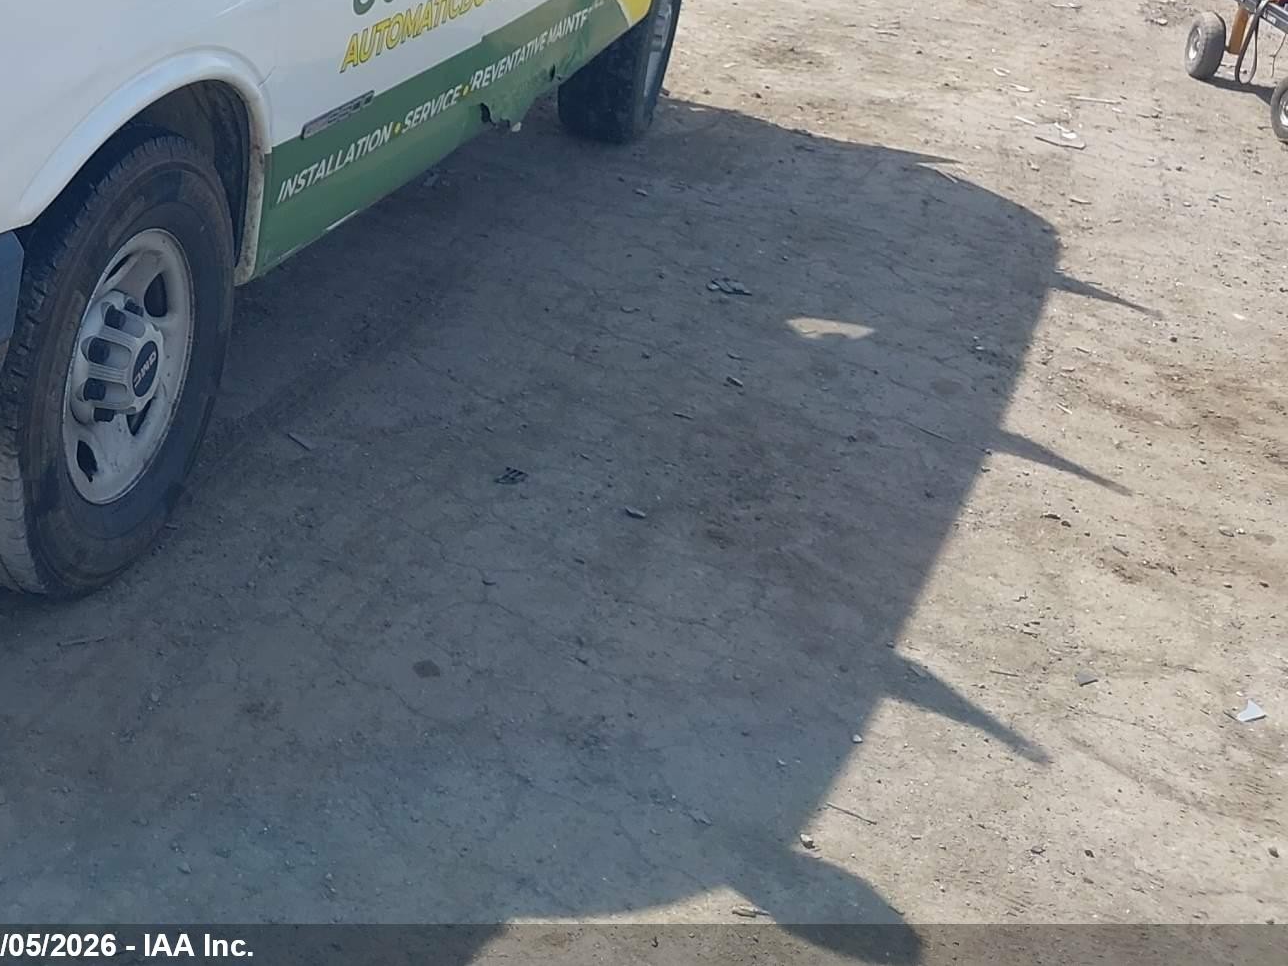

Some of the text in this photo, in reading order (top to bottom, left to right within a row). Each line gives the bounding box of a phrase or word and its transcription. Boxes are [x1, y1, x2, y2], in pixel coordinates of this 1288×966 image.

[277, 122, 393, 204] INSTALLATION
[401, 84, 462, 134] SERVICE
[469, 32, 547, 91] REVENTATIVE
[134, 351, 157, 387] GMC
